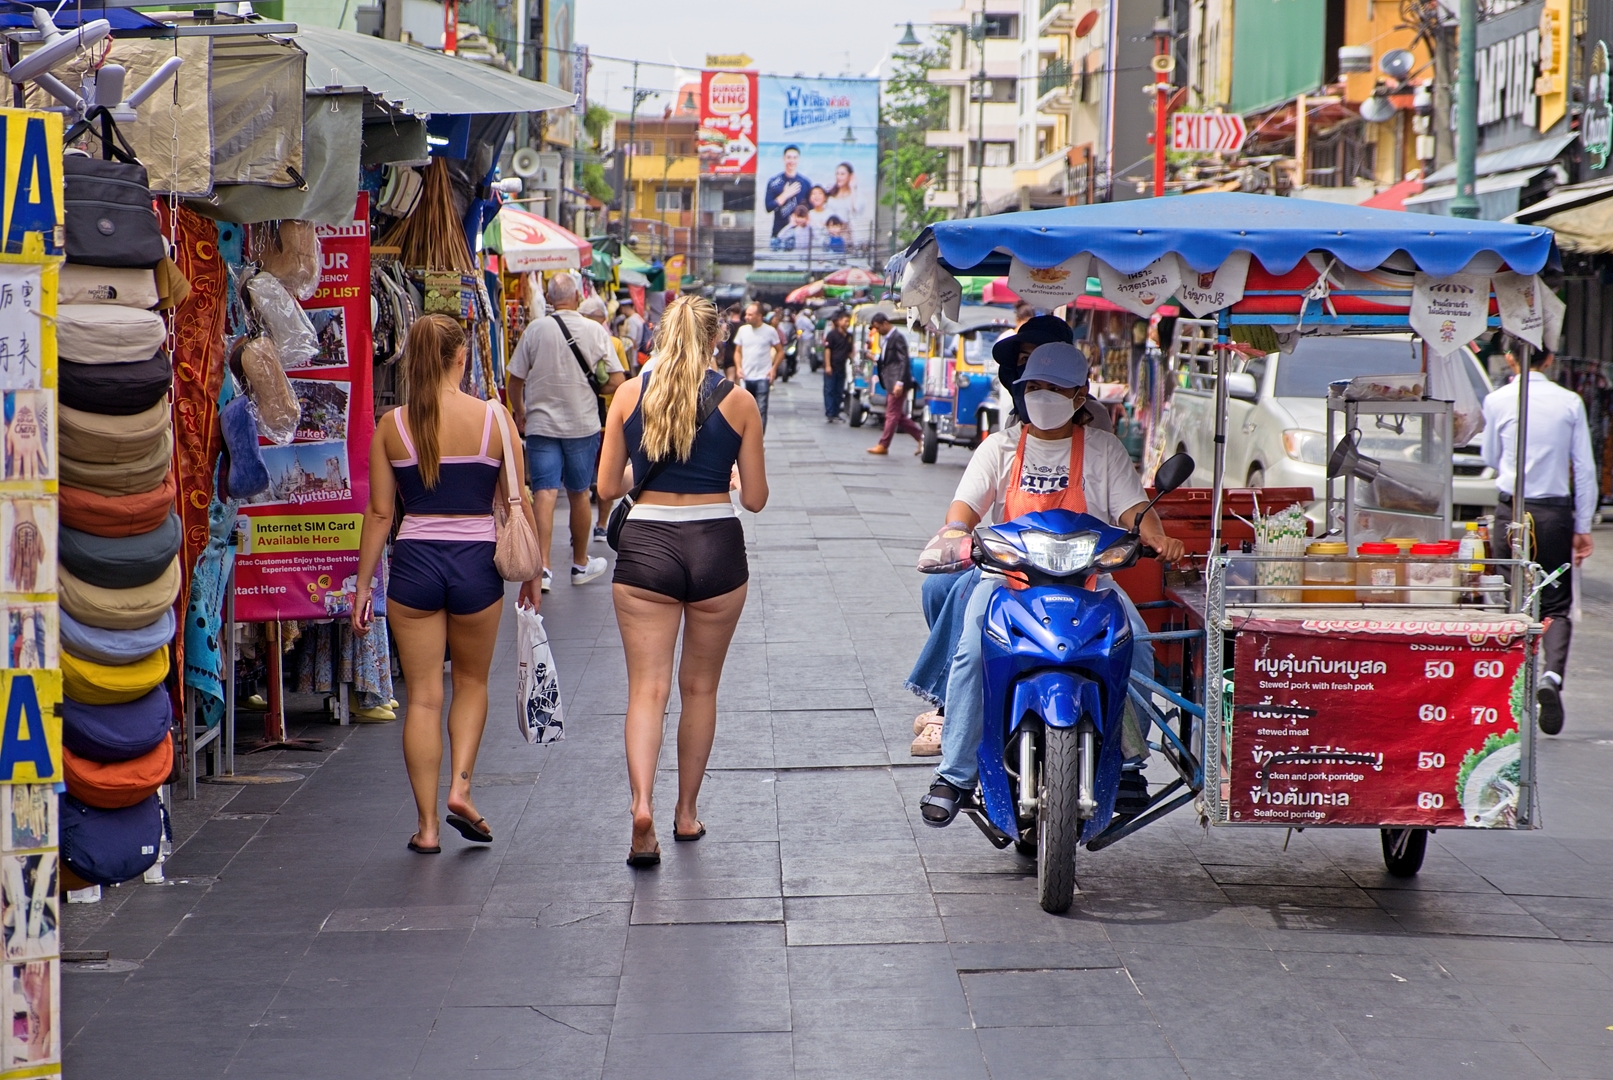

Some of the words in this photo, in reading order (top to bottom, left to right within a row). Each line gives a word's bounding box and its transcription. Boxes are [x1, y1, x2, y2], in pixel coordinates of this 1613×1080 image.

[1472, 28, 1539, 127] MPIRE
[713, 85, 746, 93] BURGER
[713, 94, 746, 104] KING
[704, 117, 729, 128] OPEN
[729, 113, 753, 132] 24
[1174, 116, 1212, 149] EXIT
[321, 253, 349, 269] UR
[319, 274, 349, 282] GENCY
[1127, 269, 1153, 280] เพราะ
[1117, 275, 1168, 293] จำสูตรไม่ได้
[313, 287, 330, 298] OP
[333, 287, 360, 298] LIST
[1182, 284, 1225, 305] ไข่มุกฟรี
[296, 428, 325, 439] arket
[1020, 475, 1069, 489] KITTE
[289, 489, 352, 505] Ayutthaya
[257, 523, 302, 533] Internet
[304, 521, 326, 532] SIM
[328, 520, 355, 531] Card
[257, 535, 310, 546] Available
[312, 534, 340, 544] Here
[254, 558, 293, 566] Customers
[294, 557, 313, 565] Enjoy
[262, 565, 301, 575] Experience
[260, 585, 287, 594] Here
[1254, 653, 1387, 679] หมูตุ๋นกับหมูสด
[1424, 660, 1455, 679] 50
[1473, 660, 1504, 679] 60
[1259, 681, 1290, 689] Stewed
[1290, 681, 1310, 691] pork
[1311, 682, 1330, 690] with
[1331, 682, 1353, 690] fresh
[1354, 682, 1375, 692] pork
[1418, 704, 1447, 722] 60
[1470, 706, 1499, 724] 70
[1257, 728, 1288, 736] stewed
[1288, 728, 1310, 736] meat
[1417, 751, 1446, 769] 50
[1255, 771, 1290, 780] Ccken
[1291, 772, 1307, 780] and
[1308, 772, 1328, 782] pork
[1329, 772, 1364, 783] porridge
[1250, 785, 1350, 806] ข้าวต้มทะเล
[1417, 792, 1445, 810] 60
[1254, 809, 1289, 818] Seafood
[1290, 810, 1326, 820] porridge
